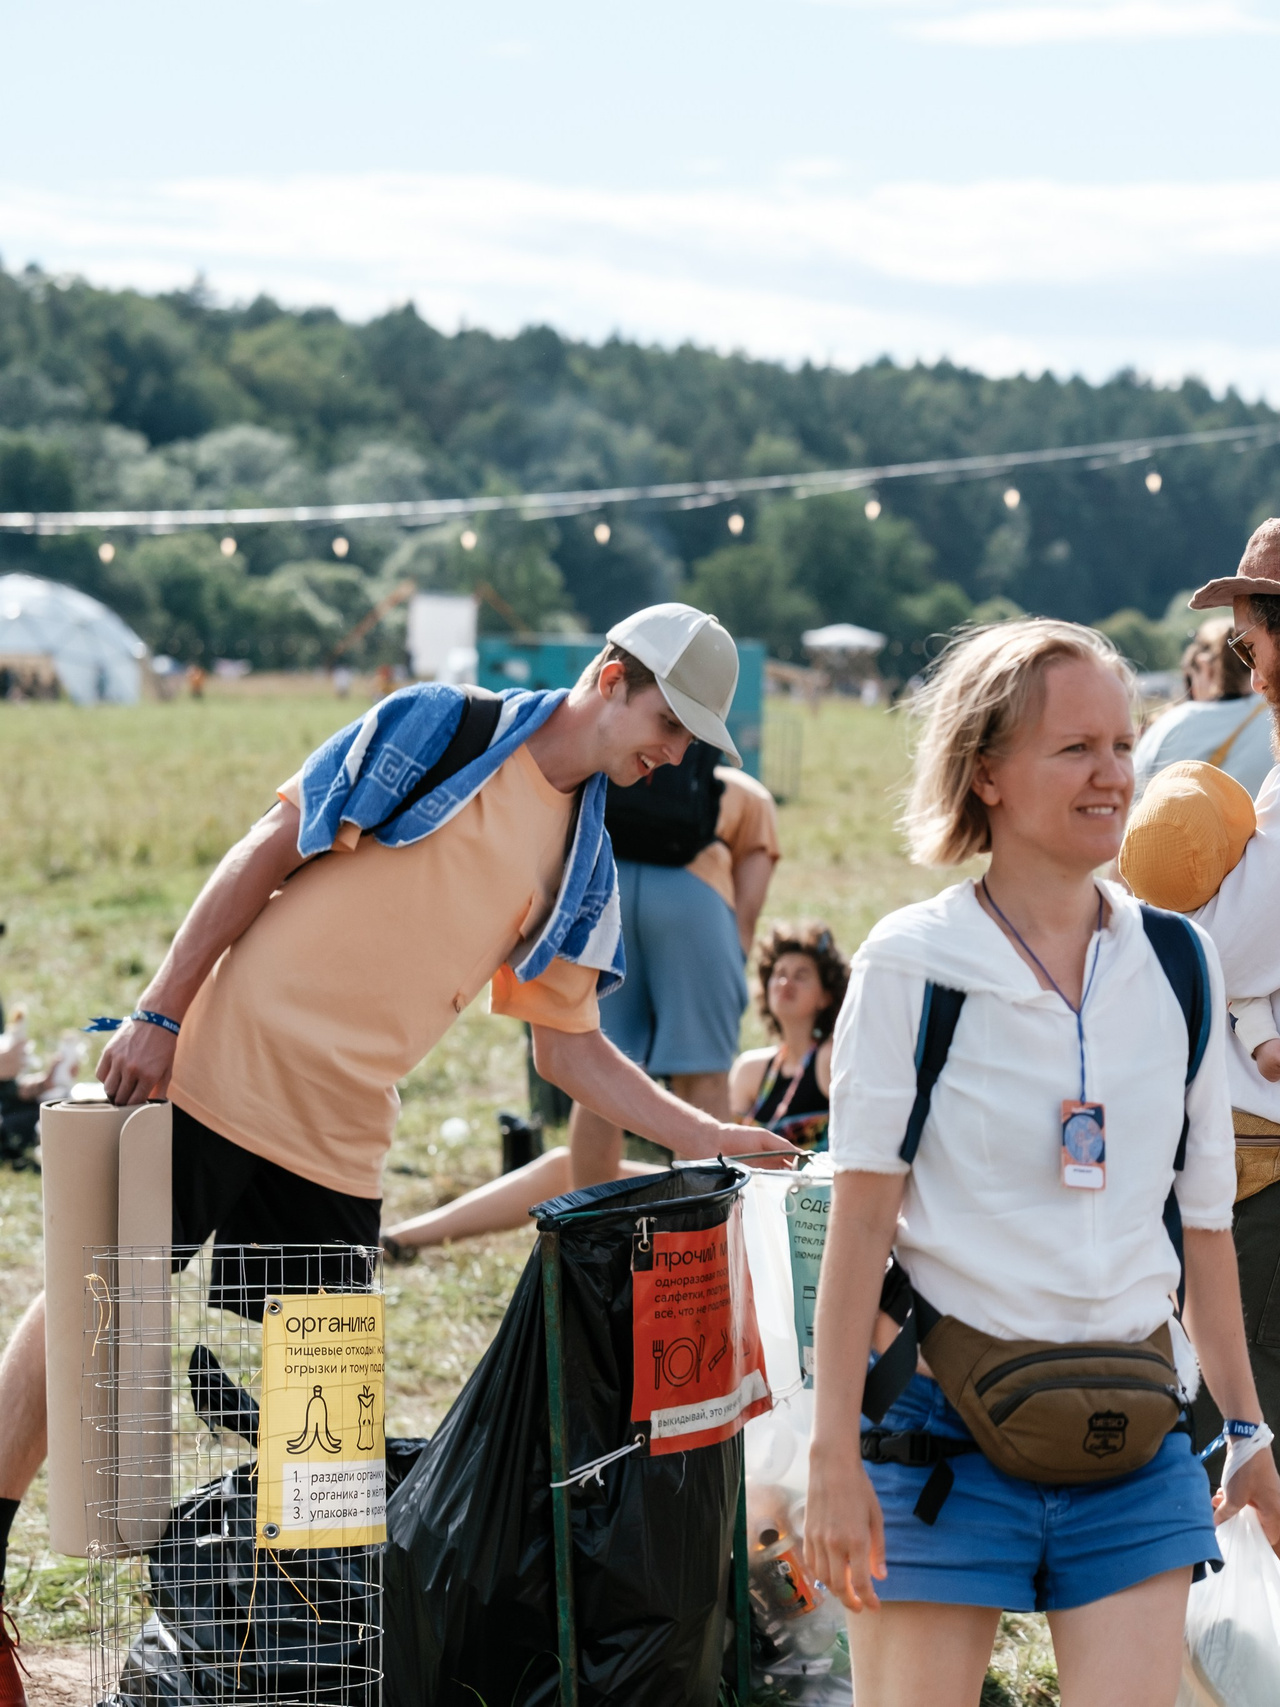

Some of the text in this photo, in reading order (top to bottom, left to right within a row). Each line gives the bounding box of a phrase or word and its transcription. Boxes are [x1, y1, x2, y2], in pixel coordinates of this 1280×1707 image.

[655, 1243, 716, 1272] прочий
[654, 1307, 677, 1319] всё,
[678, 1307, 694, 1317] что
[696, 1305, 707, 1315] не
[285, 1316, 376, 1340] органика
[286, 1346, 343, 1358] пищевые
[284, 1364, 338, 1378] огрызки
[340, 1364, 347, 1374] и
[349, 1363, 369, 1376] тому
[709, 1407, 723, 1418] это
[293, 1470, 302, 1483] 1.
[310, 1472, 355, 1486] раздели
[293, 1488, 304, 1502] 2.
[310, 1489, 359, 1503] органика
[366, 1489, 371, 1499] в
[293, 1506, 304, 1520] 3.
[309, 1508, 358, 1522] упаковка
[365, 1507, 371, 1517] в
